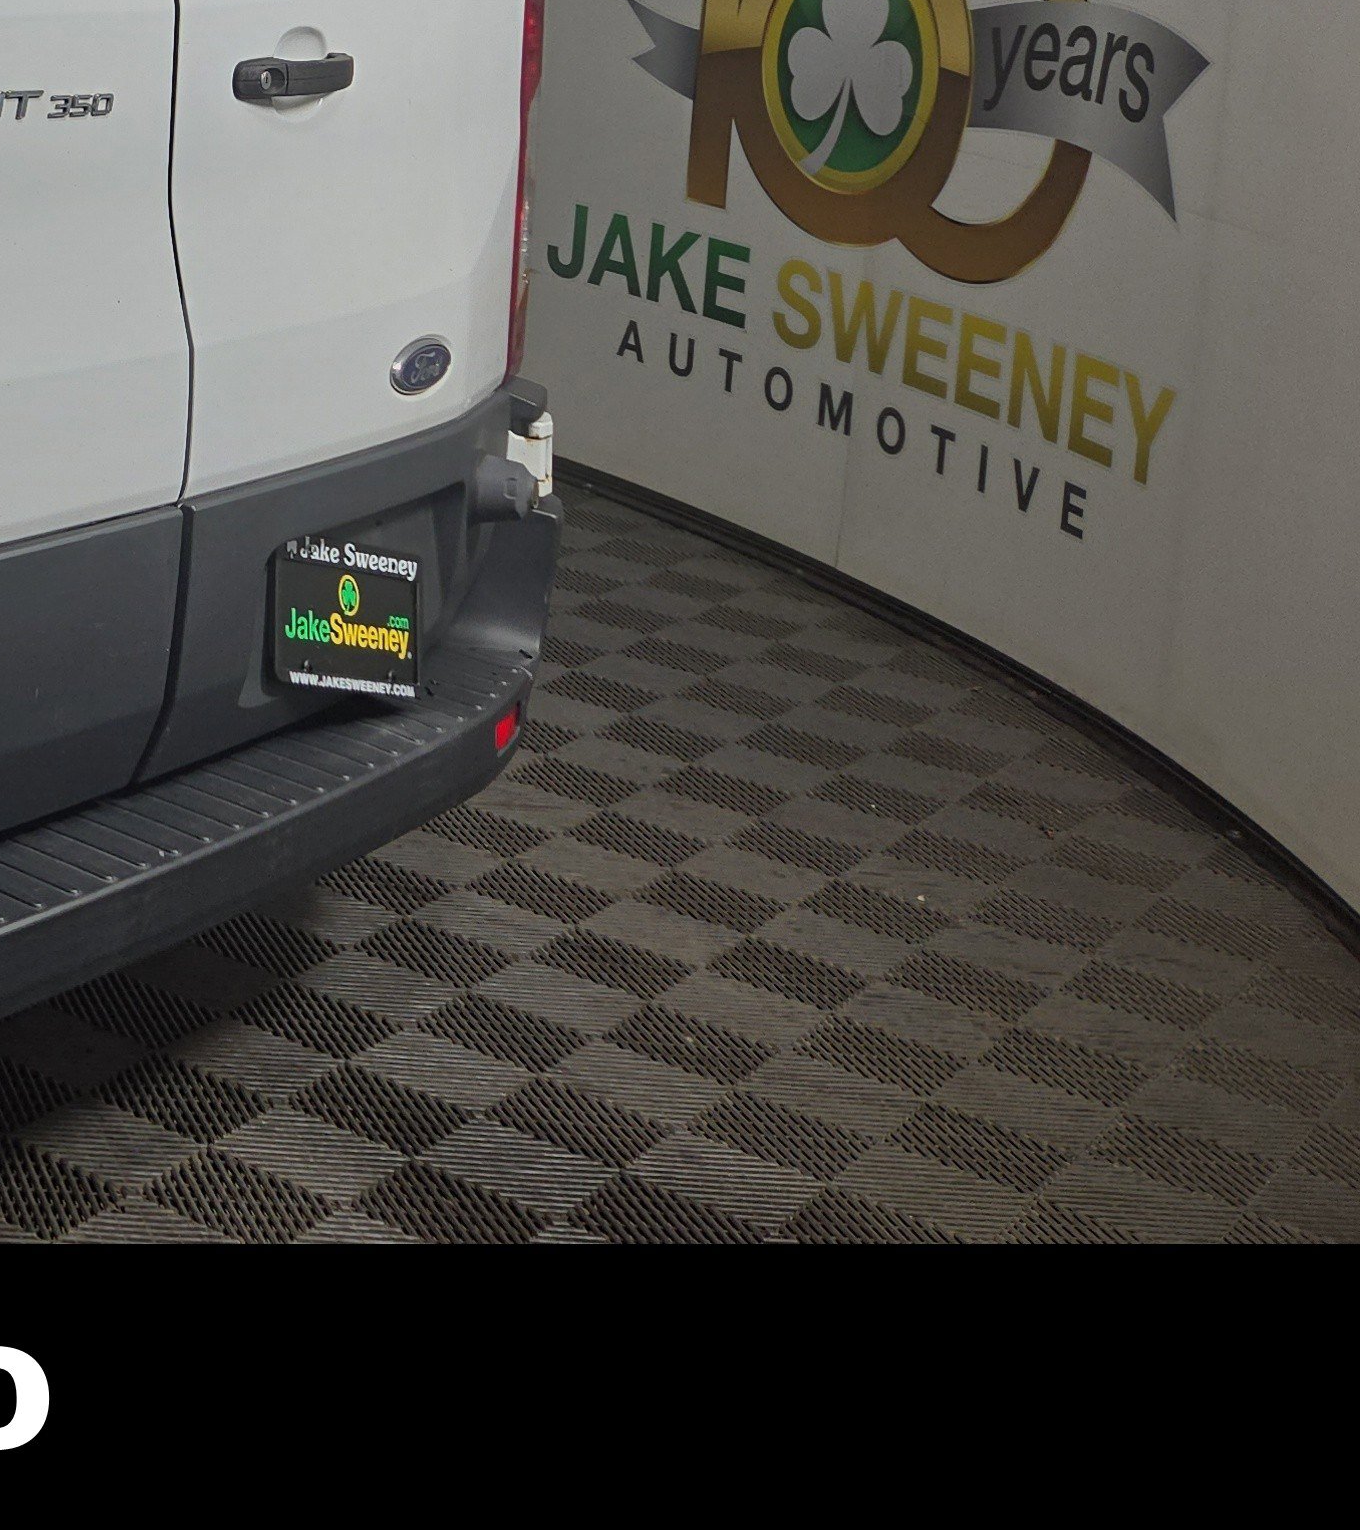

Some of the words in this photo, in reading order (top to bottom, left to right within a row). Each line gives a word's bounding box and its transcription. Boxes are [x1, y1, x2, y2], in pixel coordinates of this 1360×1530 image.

[47, 93, 115, 120] 350
[983, 21, 1155, 123] years
[547, 204, 751, 329] JAKE
[771, 257, 1176, 485] SWEENEY
[617, 319, 1087, 540] AUTOMOTIVE
[300, 536, 340, 564] Jake
[344, 543, 418, 582] Sweeney
[289, 670, 416, 699] WWW.JAKESWEENEY.COM
